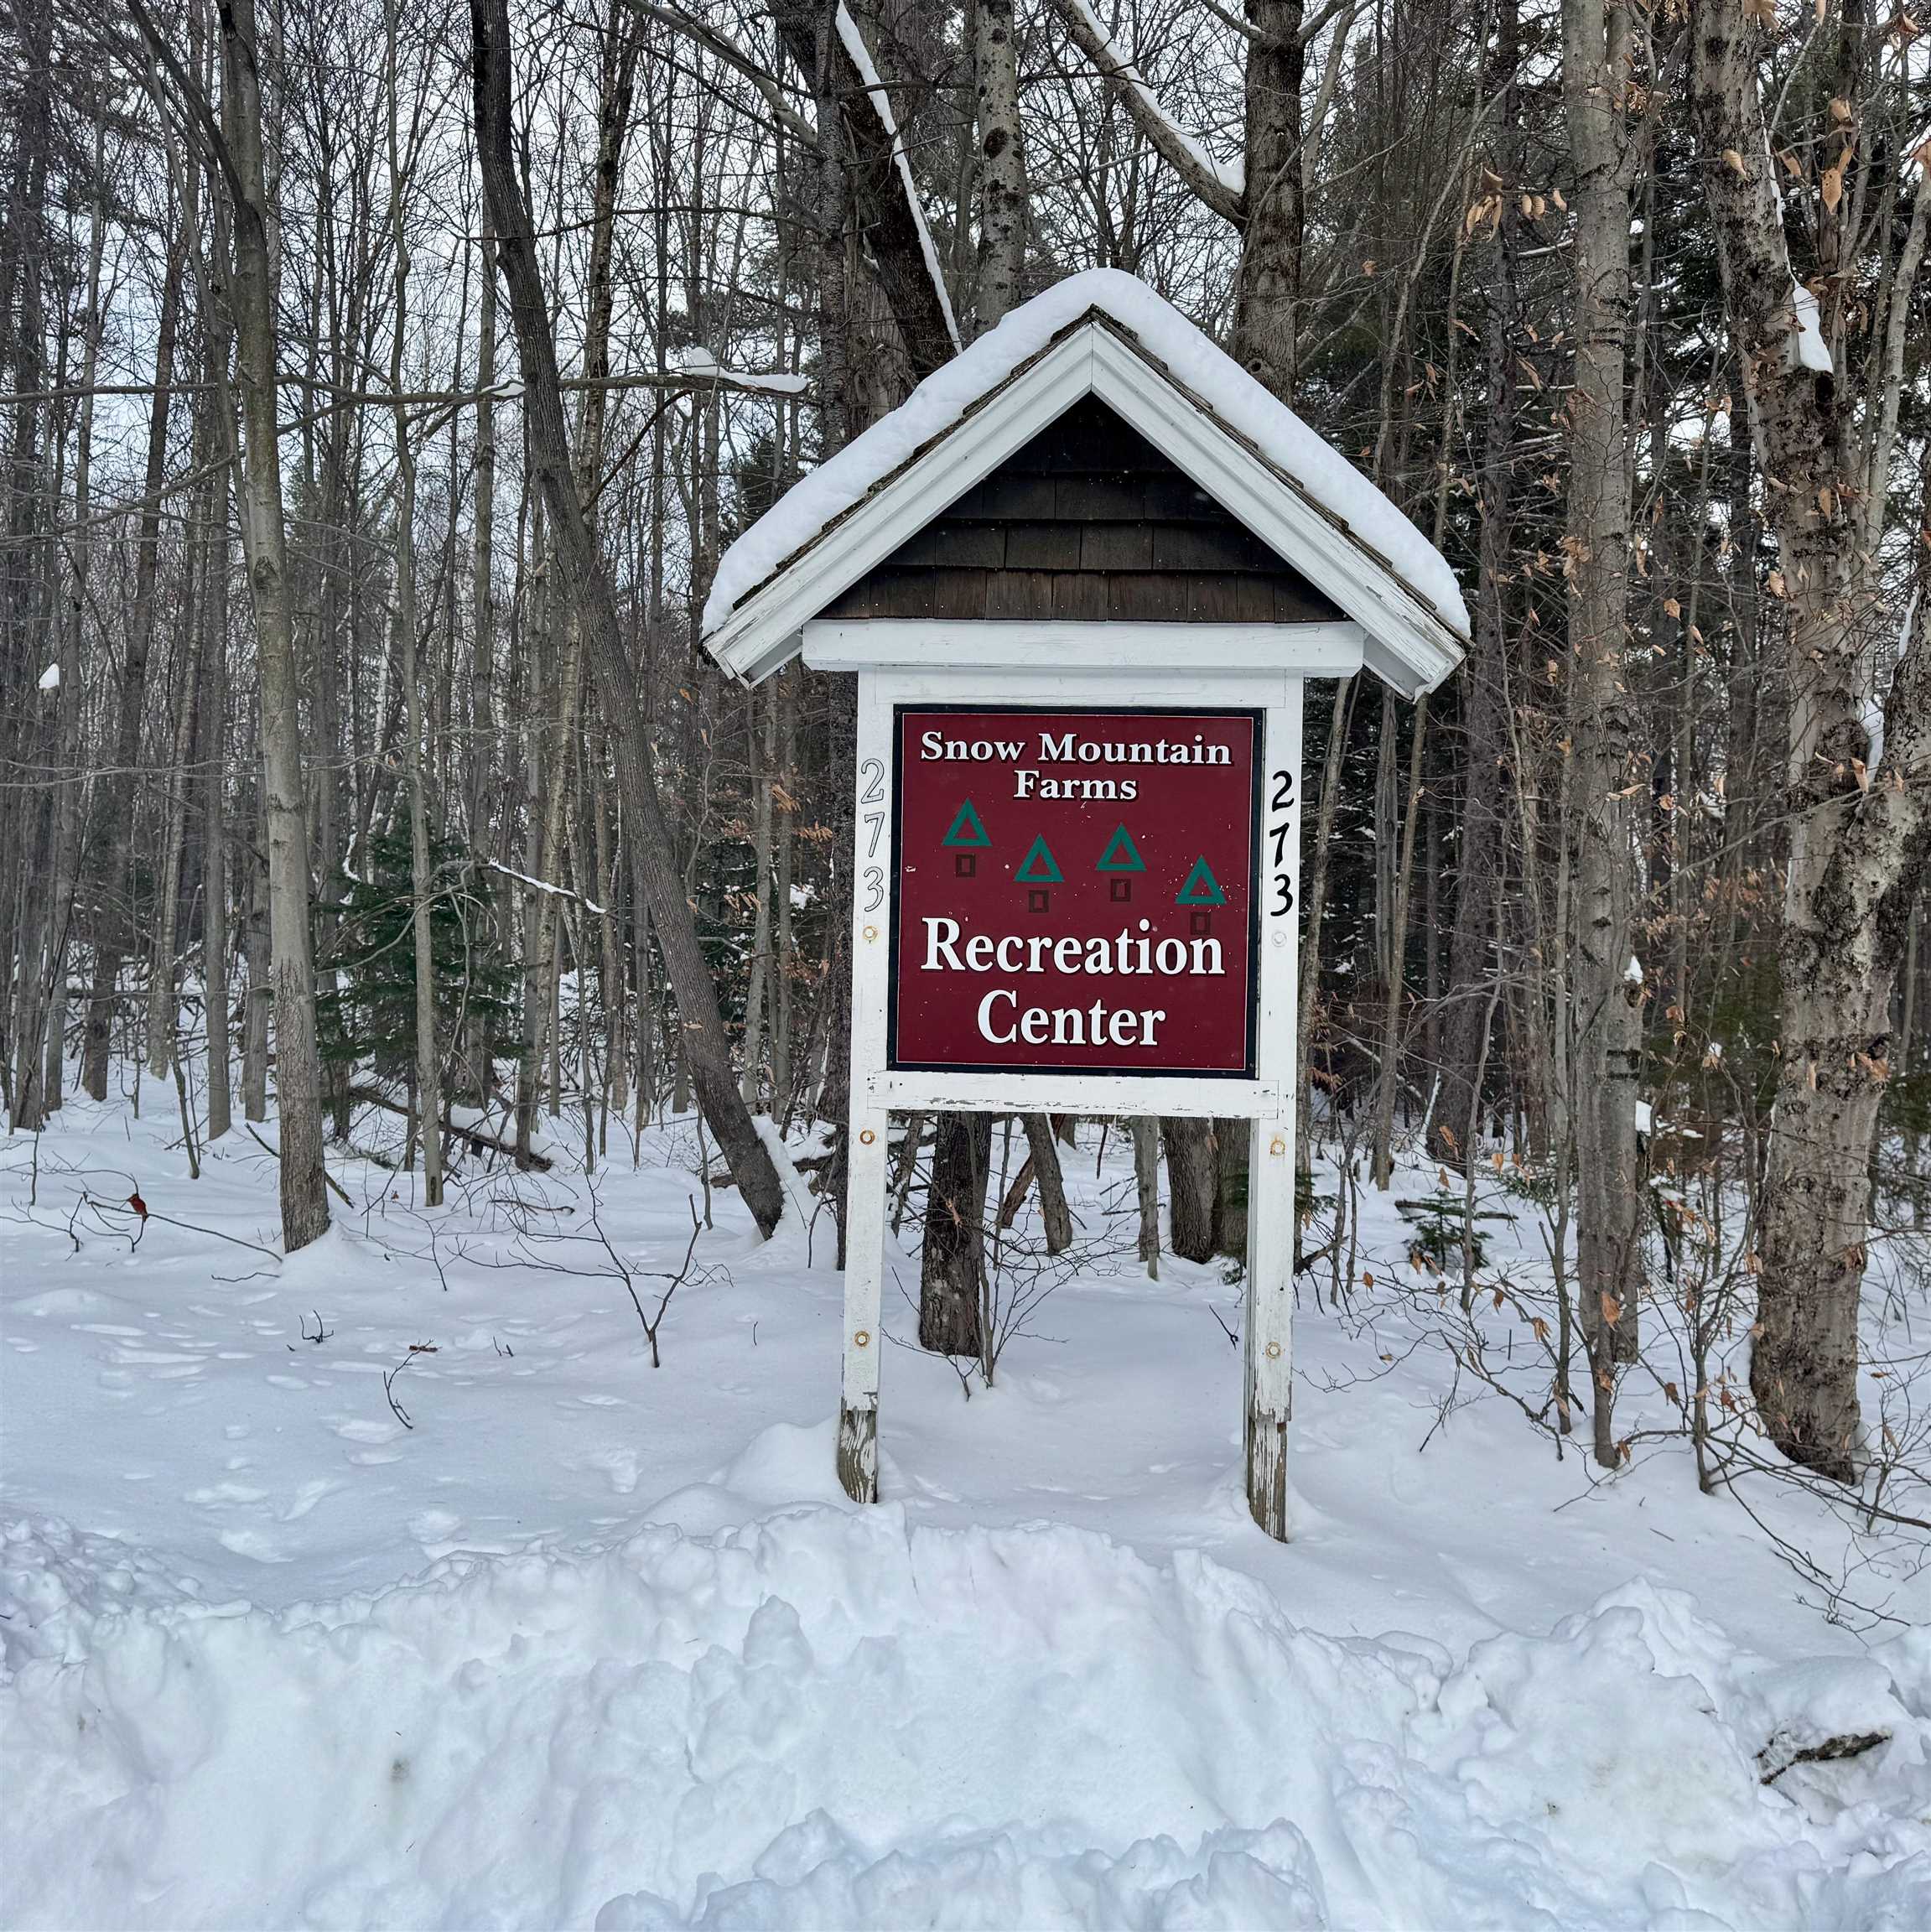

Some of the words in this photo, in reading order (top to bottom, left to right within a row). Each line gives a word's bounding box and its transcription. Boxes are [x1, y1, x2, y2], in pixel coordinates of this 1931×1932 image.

[921, 731, 1025, 761] Snow
[1038, 732, 1233, 765] Mountain
[1014, 770, 1138, 800] Farms
[860, 758, 885, 912] 273
[1269, 770, 1295, 917] 273
[921, 917, 1226, 975] Recreation
[978, 989, 1166, 1046] Center
